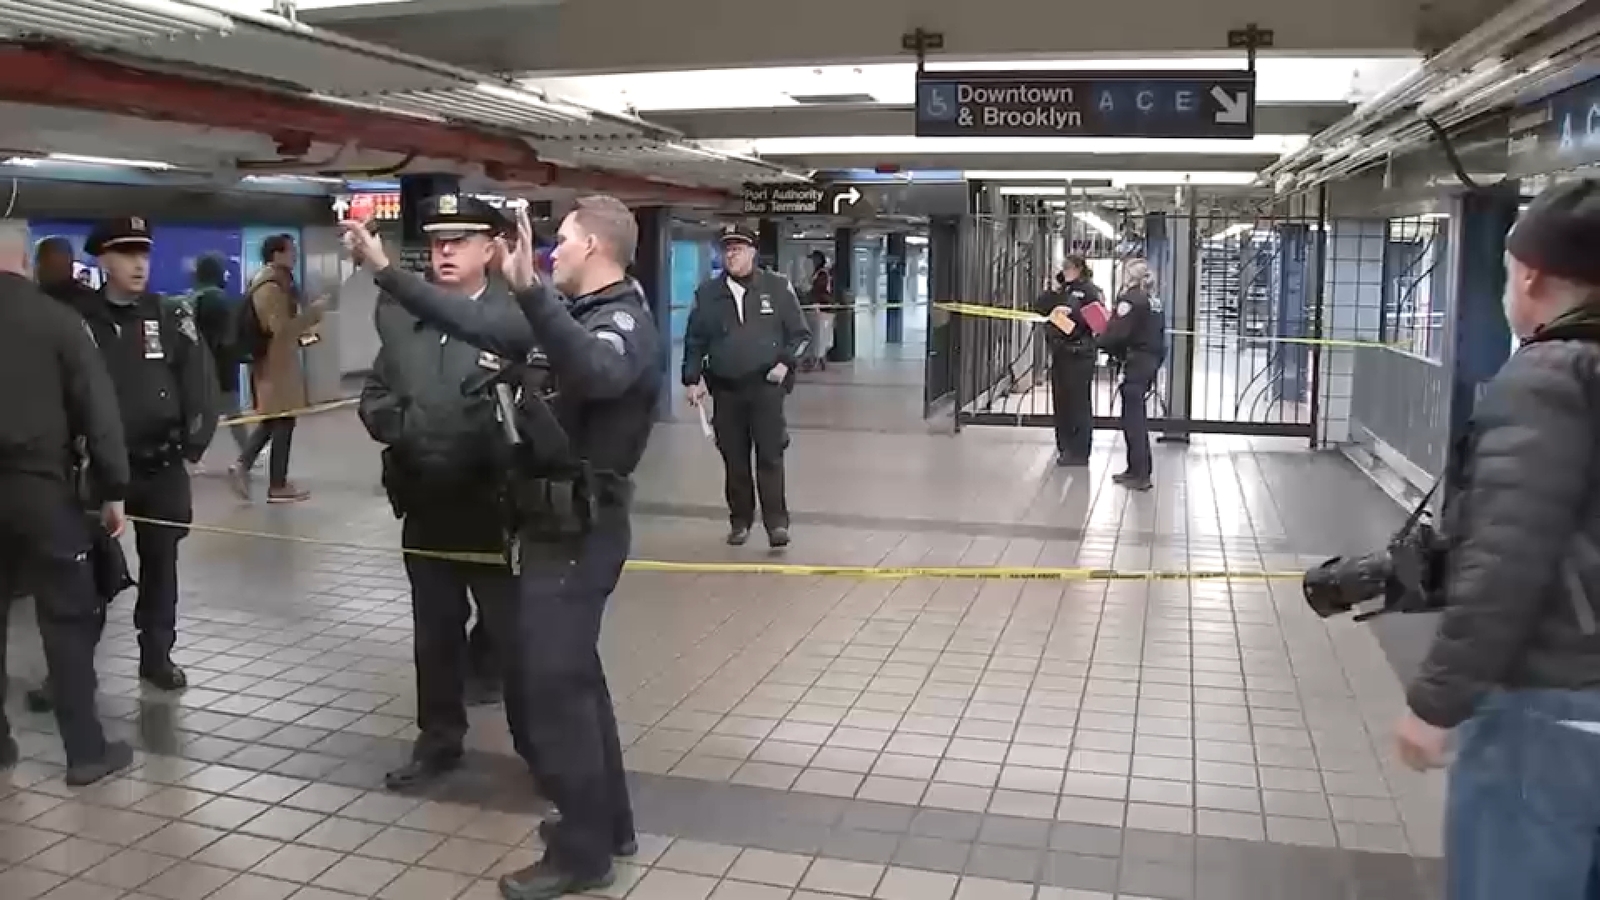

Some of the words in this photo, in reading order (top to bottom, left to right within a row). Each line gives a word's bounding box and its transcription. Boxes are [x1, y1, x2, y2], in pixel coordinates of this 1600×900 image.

[957, 85, 1074, 105] Downtown
[1099, 91, 1114, 111] A
[1137, 91, 1154, 111] C
[1175, 91, 1193, 111] E
[957, 107, 974, 126] &
[983, 107, 1082, 129] Brooklyn
[1559, 113, 1574, 149] A
[744, 189, 767, 200] Port
[772, 189, 824, 202] Authority
[744, 202, 766, 211] Bus
[771, 202, 817, 211] Terminal
